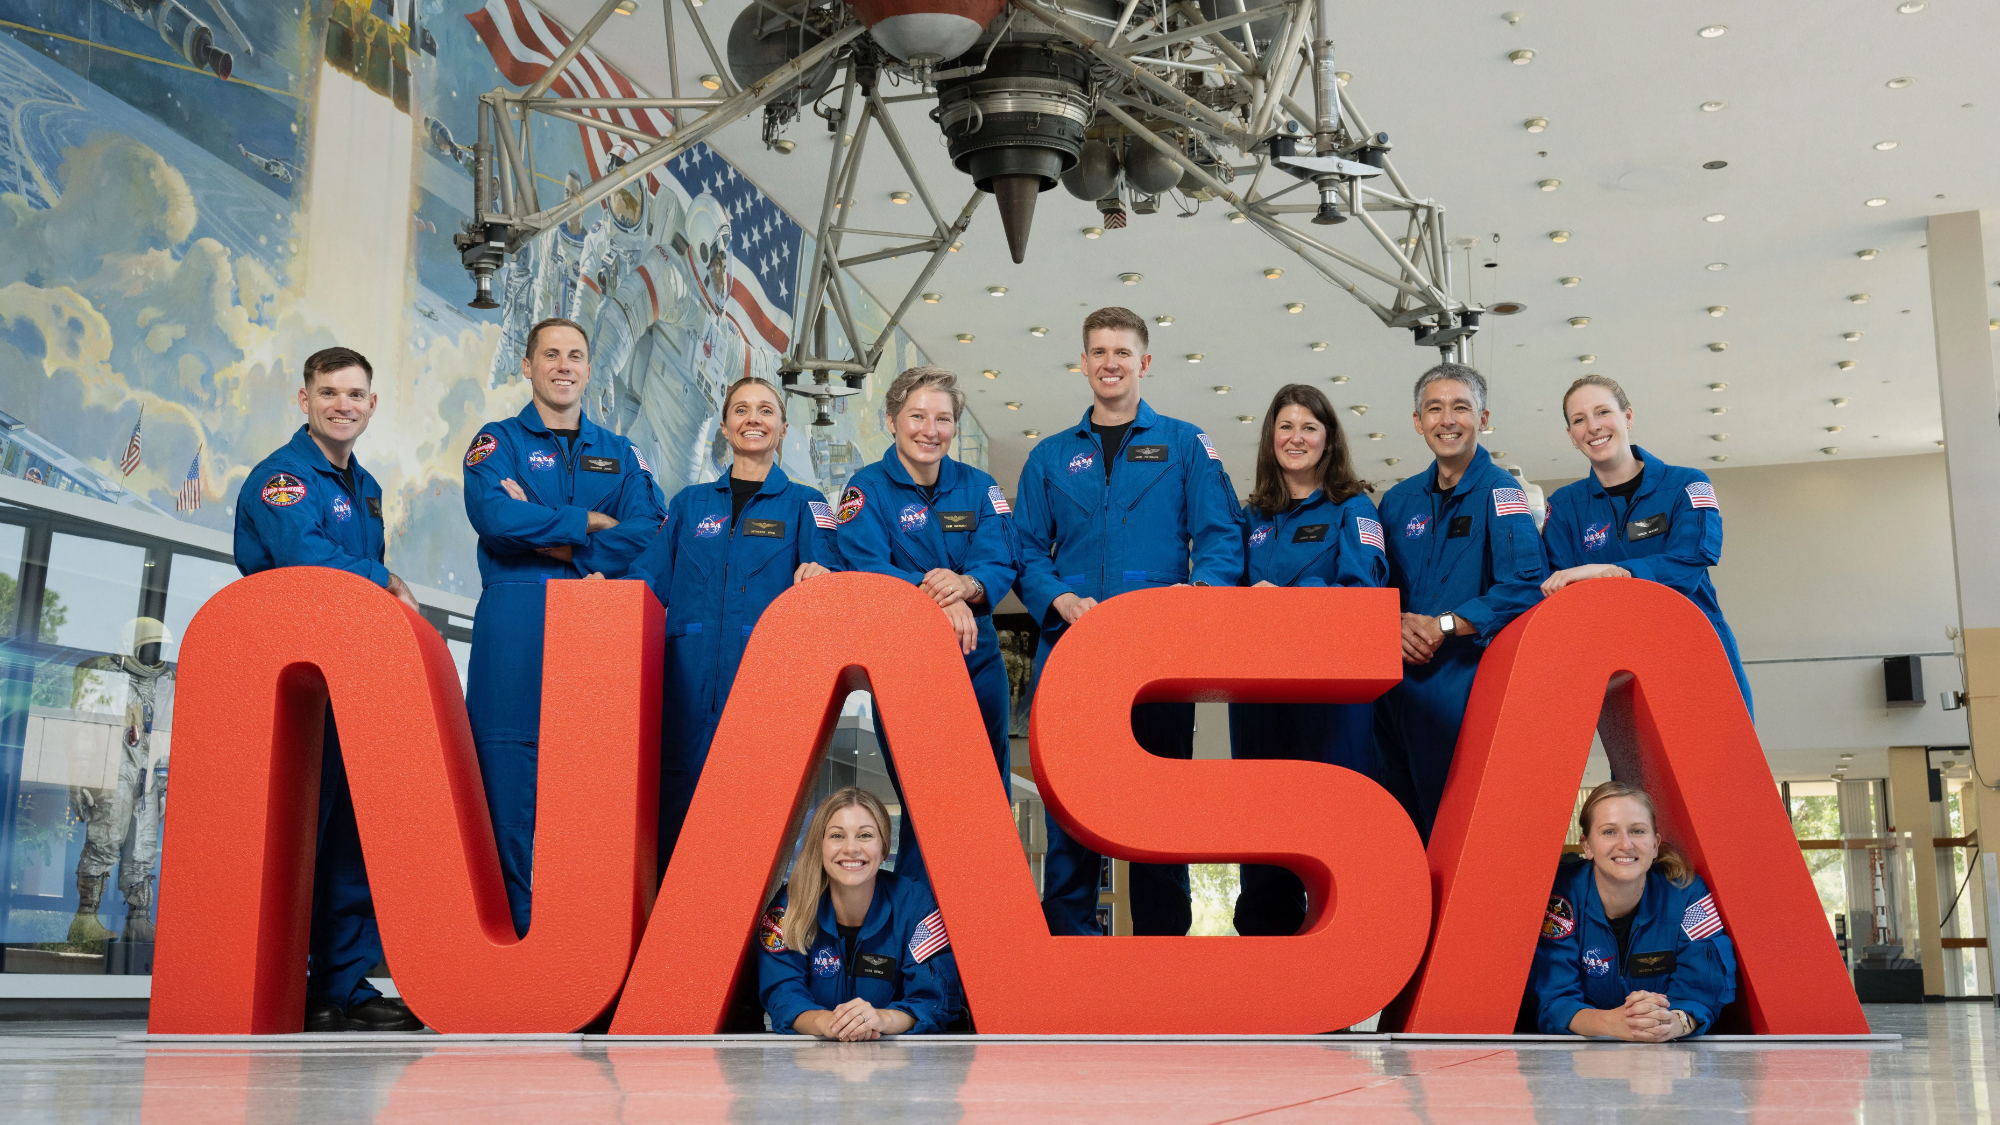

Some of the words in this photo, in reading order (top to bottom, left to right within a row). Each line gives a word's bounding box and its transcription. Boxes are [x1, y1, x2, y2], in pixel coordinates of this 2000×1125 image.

[529, 456, 555, 464] NASA
[1069, 458, 1093, 468] NASA
[333, 503, 352, 514] NASA
[900, 513, 926, 523] NASA
[697, 521, 722, 530] NASA
[1406, 523, 1425, 531] NASA
[1584, 532, 1606, 542] NASA
[148, 566, 1870, 1035] NASA
[814, 956, 841, 967] NASA
[1582, 955, 1610, 969] NASA
